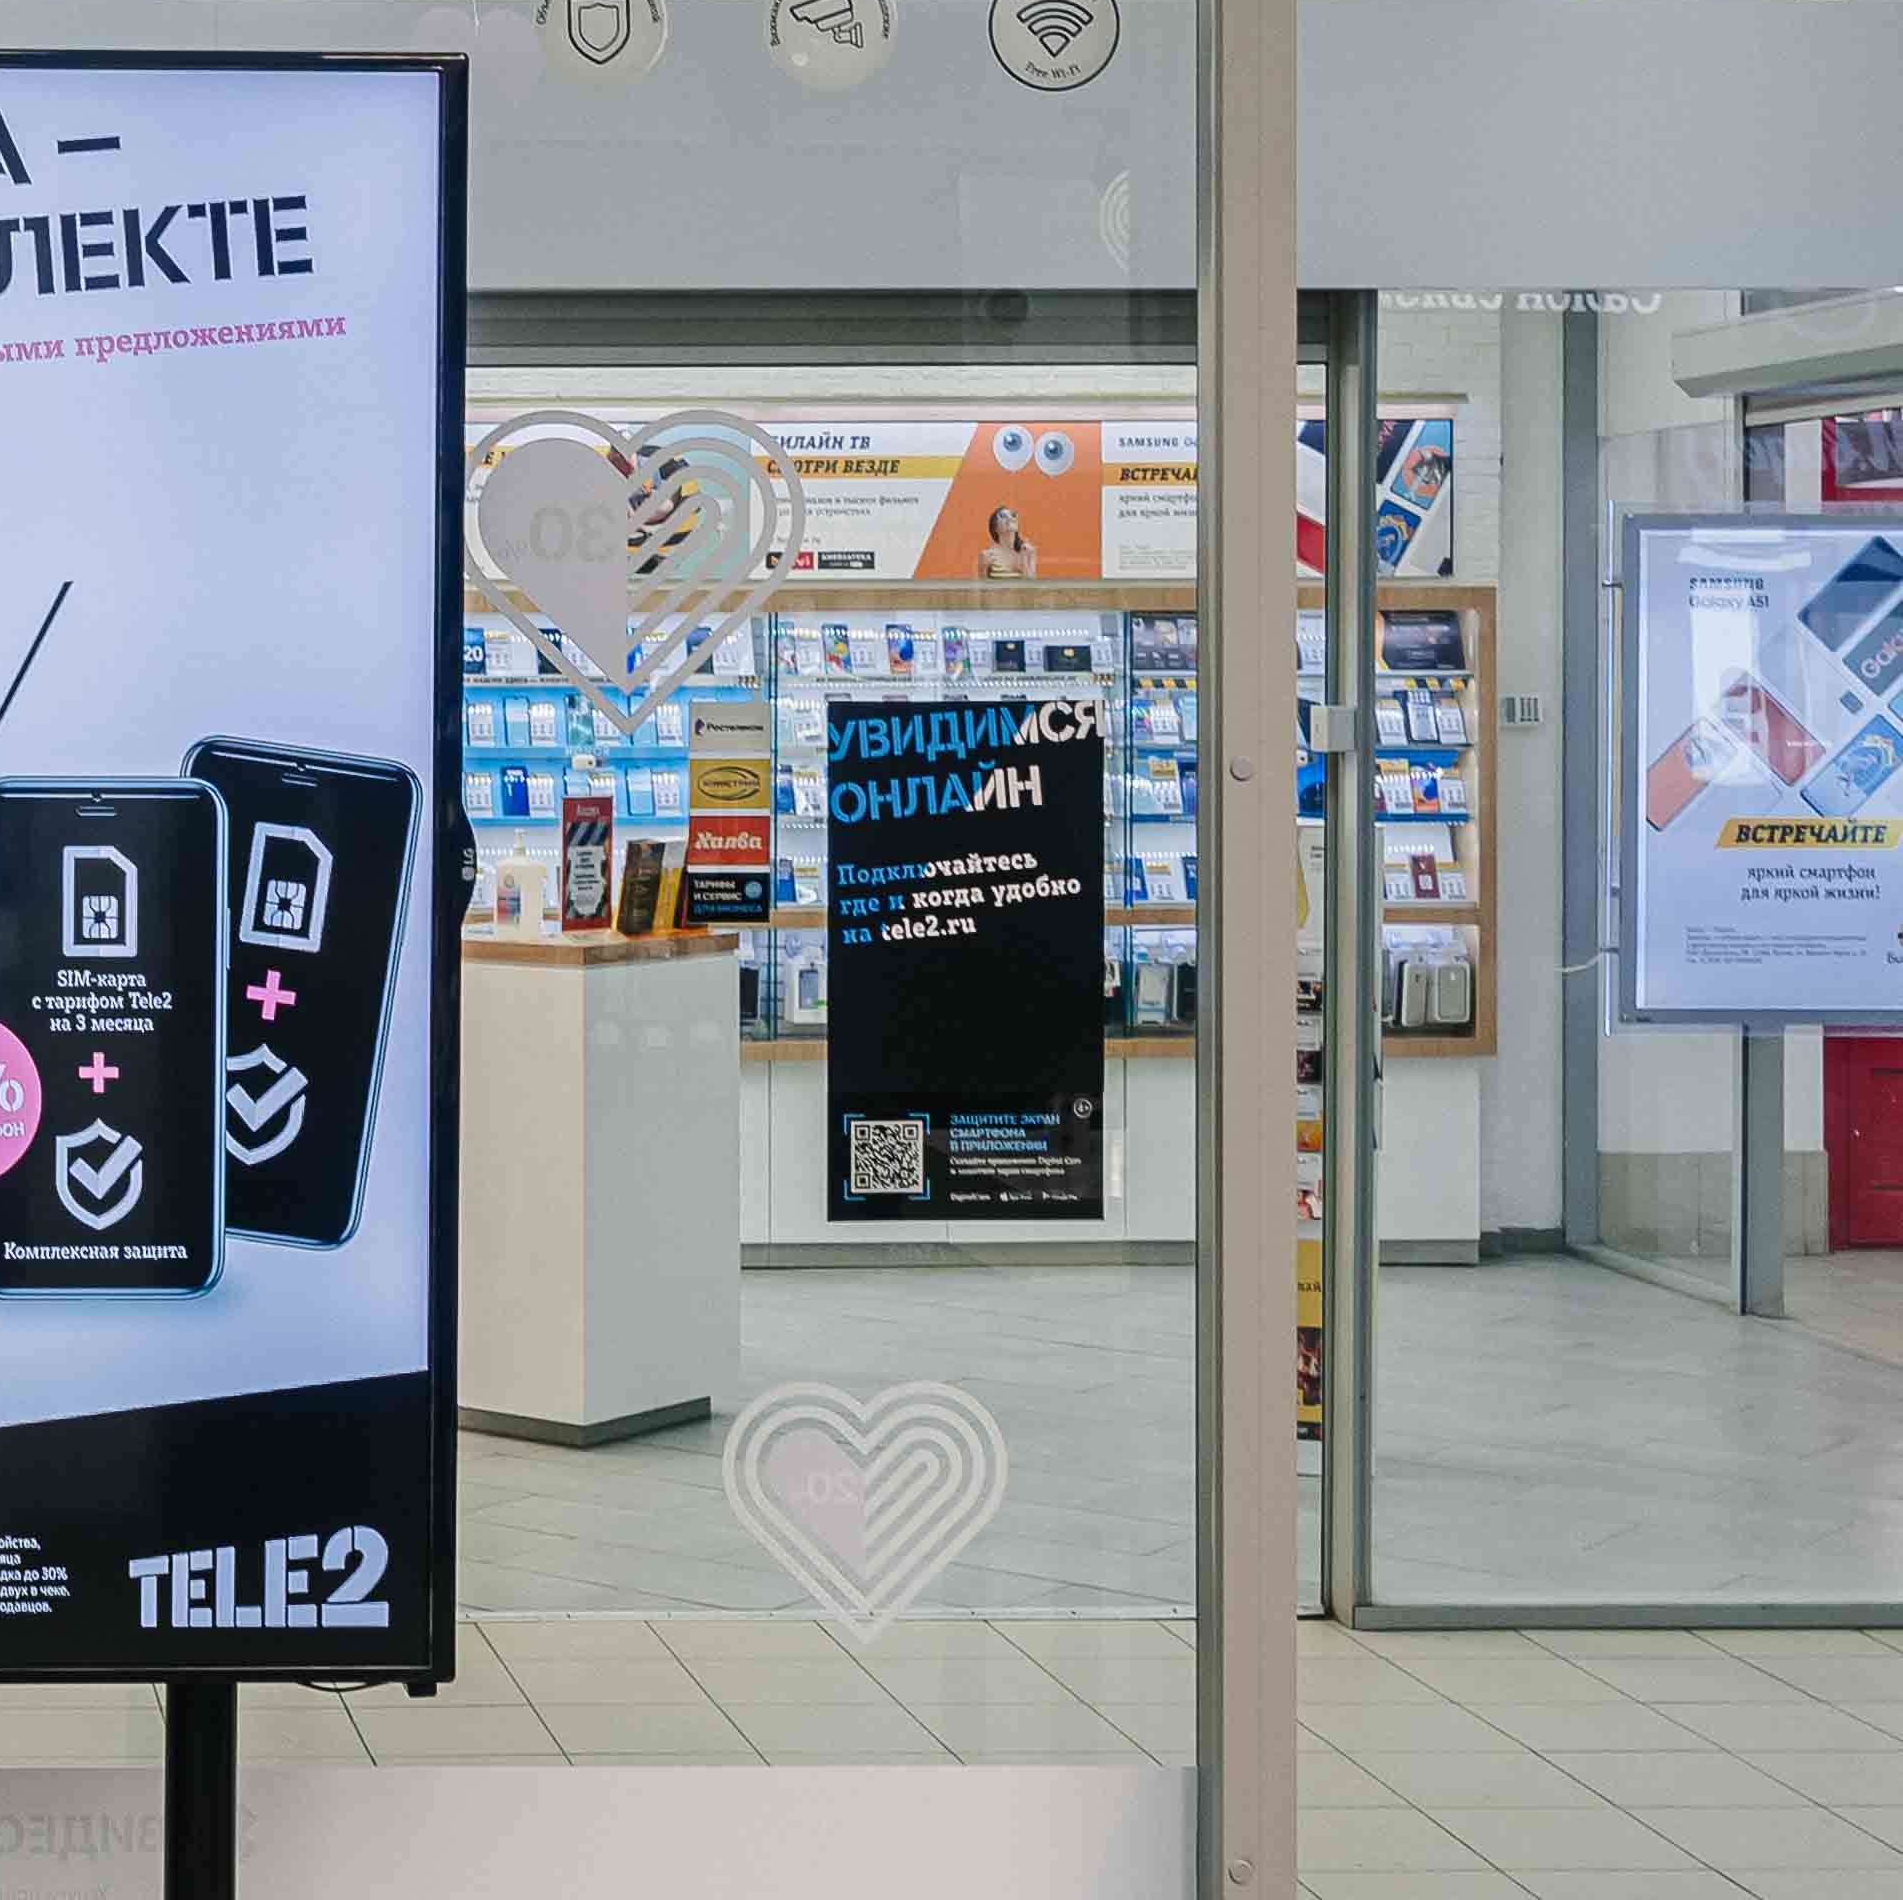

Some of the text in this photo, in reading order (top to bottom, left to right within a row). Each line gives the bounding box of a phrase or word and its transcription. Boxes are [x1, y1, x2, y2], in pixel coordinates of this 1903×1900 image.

[73, 312, 348, 364] предложениями
[850, 436, 871, 450] ТВ
[1119, 437, 1178, 447] SAMSUNG
[843, 459, 900, 476] ВЕЗДЕ
[829, 701, 1104, 762] УВИДИМСЯ
[831, 763, 1043, 823] ОНЛАЙН
[695, 831, 762, 850] Халва
[1735, 816, 1887, 845] ВСТРЕЧАЙТЕ
[837, 853, 1038, 887] Подключайтесь
[1747, 863, 1877, 883] яркий смартфон
[841, 875, 1082, 917] где и когда удобно
[1740, 883, 1882, 902] для яркой жизни!
[842, 915, 977, 944] на tele2.ru
[57, 969, 147, 990] SIM-карта
[32, 991, 173, 1015] с тарифом Tele2
[50, 1014, 155, 1034] на 3 месяца
[950, 1114, 1060, 1125] ЗАЩИТИТЕ ЭКРАН
[950, 1128, 1026, 1138] СМАРТФОНА
[4, 1241, 189, 1263] Комплексная защита
[24, 1569, 39, 1582] до
[41, 1566, 68, 1581] 30%
[129, 1525, 389, 1628] TELE2
[0, 1586, 28, 1599] двух
